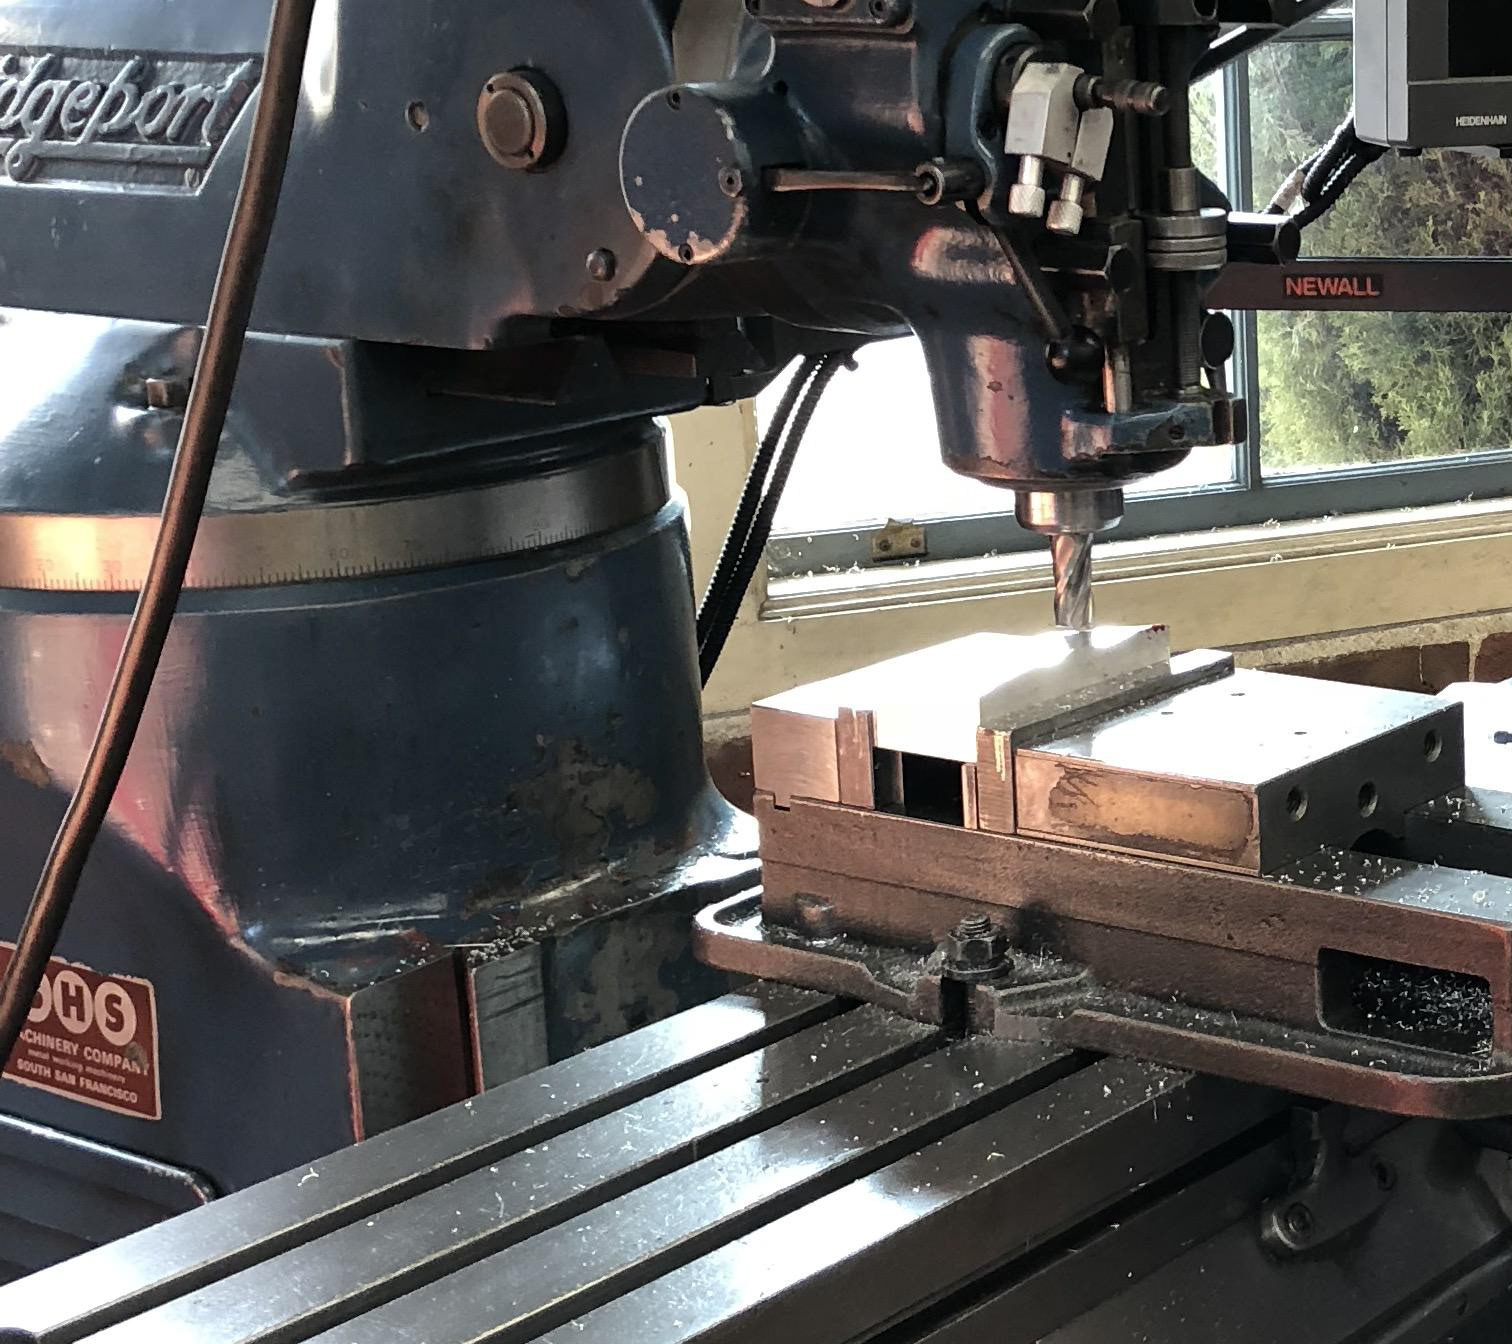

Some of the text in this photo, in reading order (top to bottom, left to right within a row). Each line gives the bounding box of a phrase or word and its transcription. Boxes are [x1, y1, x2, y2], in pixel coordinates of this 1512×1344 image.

[1456, 115, 1507, 126] HEIDENHAIN
[1285, 276, 1380, 297] NEWALL
[84, 1047, 149, 1076] COMPANY
[17, 1058, 138, 1104] SOUTH SAN FRANCISCO
